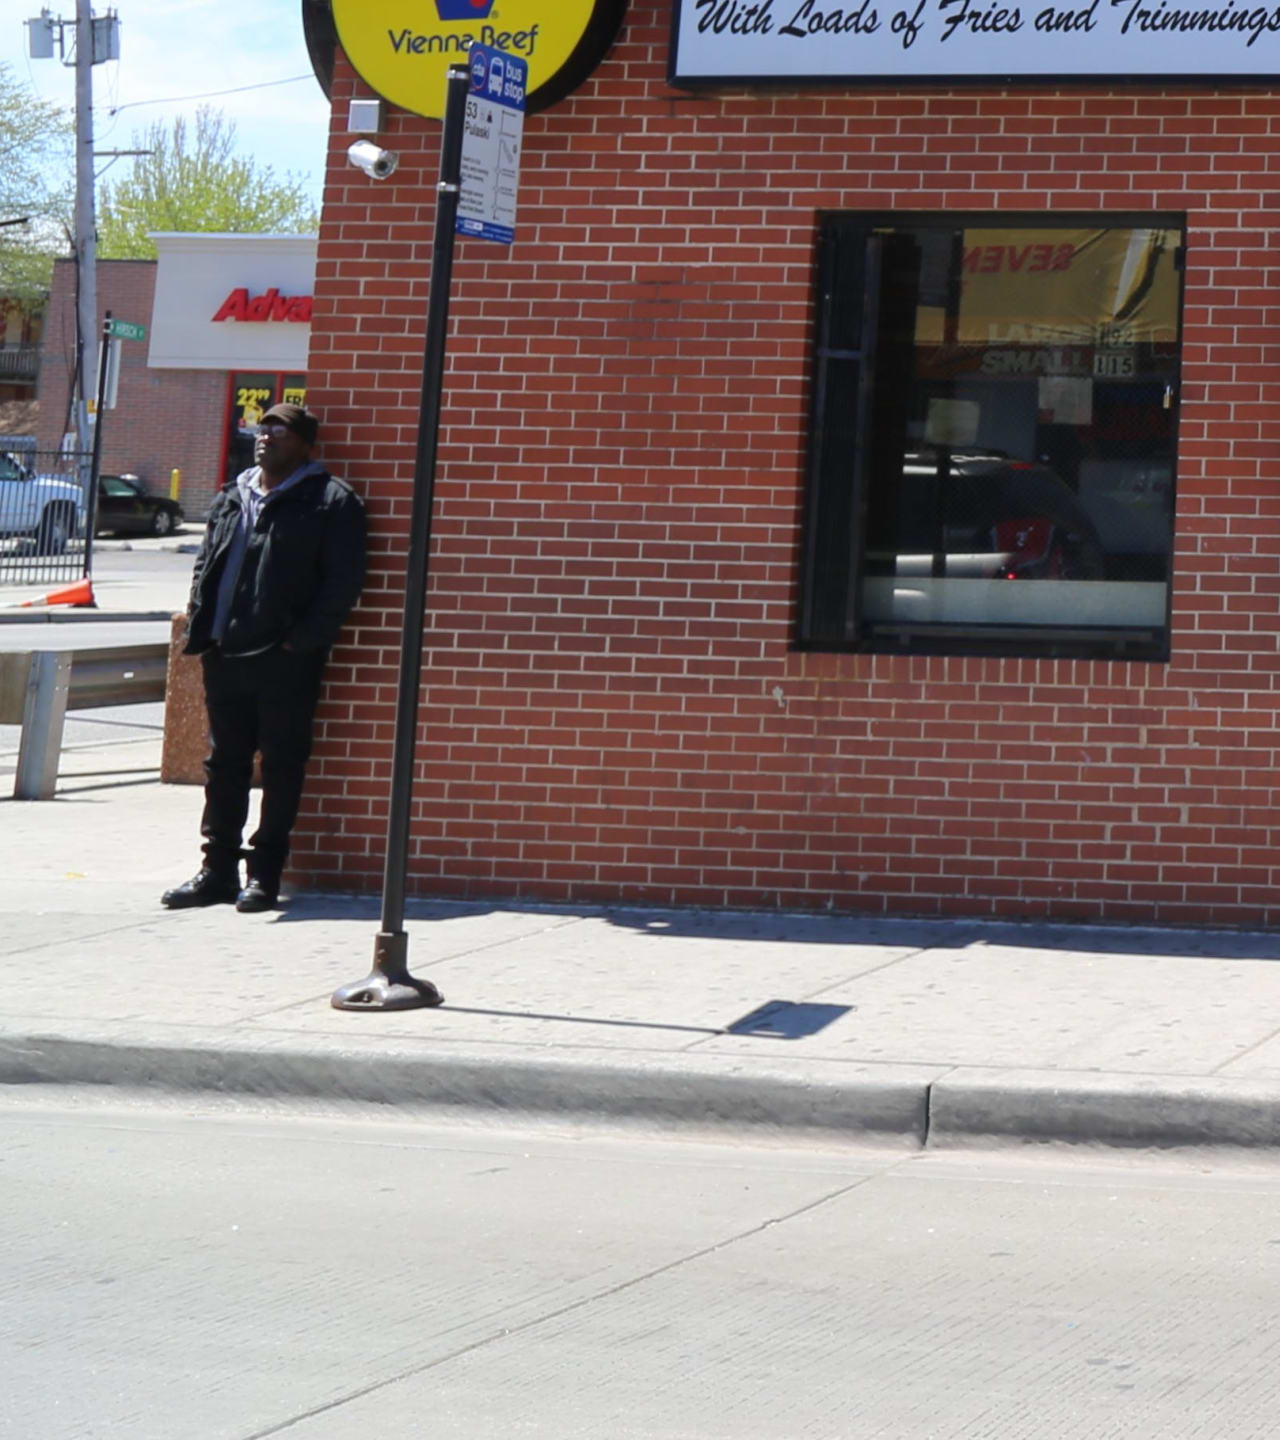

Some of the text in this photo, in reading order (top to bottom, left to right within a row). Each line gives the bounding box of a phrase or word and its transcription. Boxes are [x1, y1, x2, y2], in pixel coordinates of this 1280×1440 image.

[387, 24, 540, 57] Vienna Beef
[506, 60, 522, 82] bus
[504, 81, 524, 104] stop
[466, 101, 478, 119] 53
[464, 120, 490, 140] Pulaski
[116, 322, 137, 338] HIRSCH
